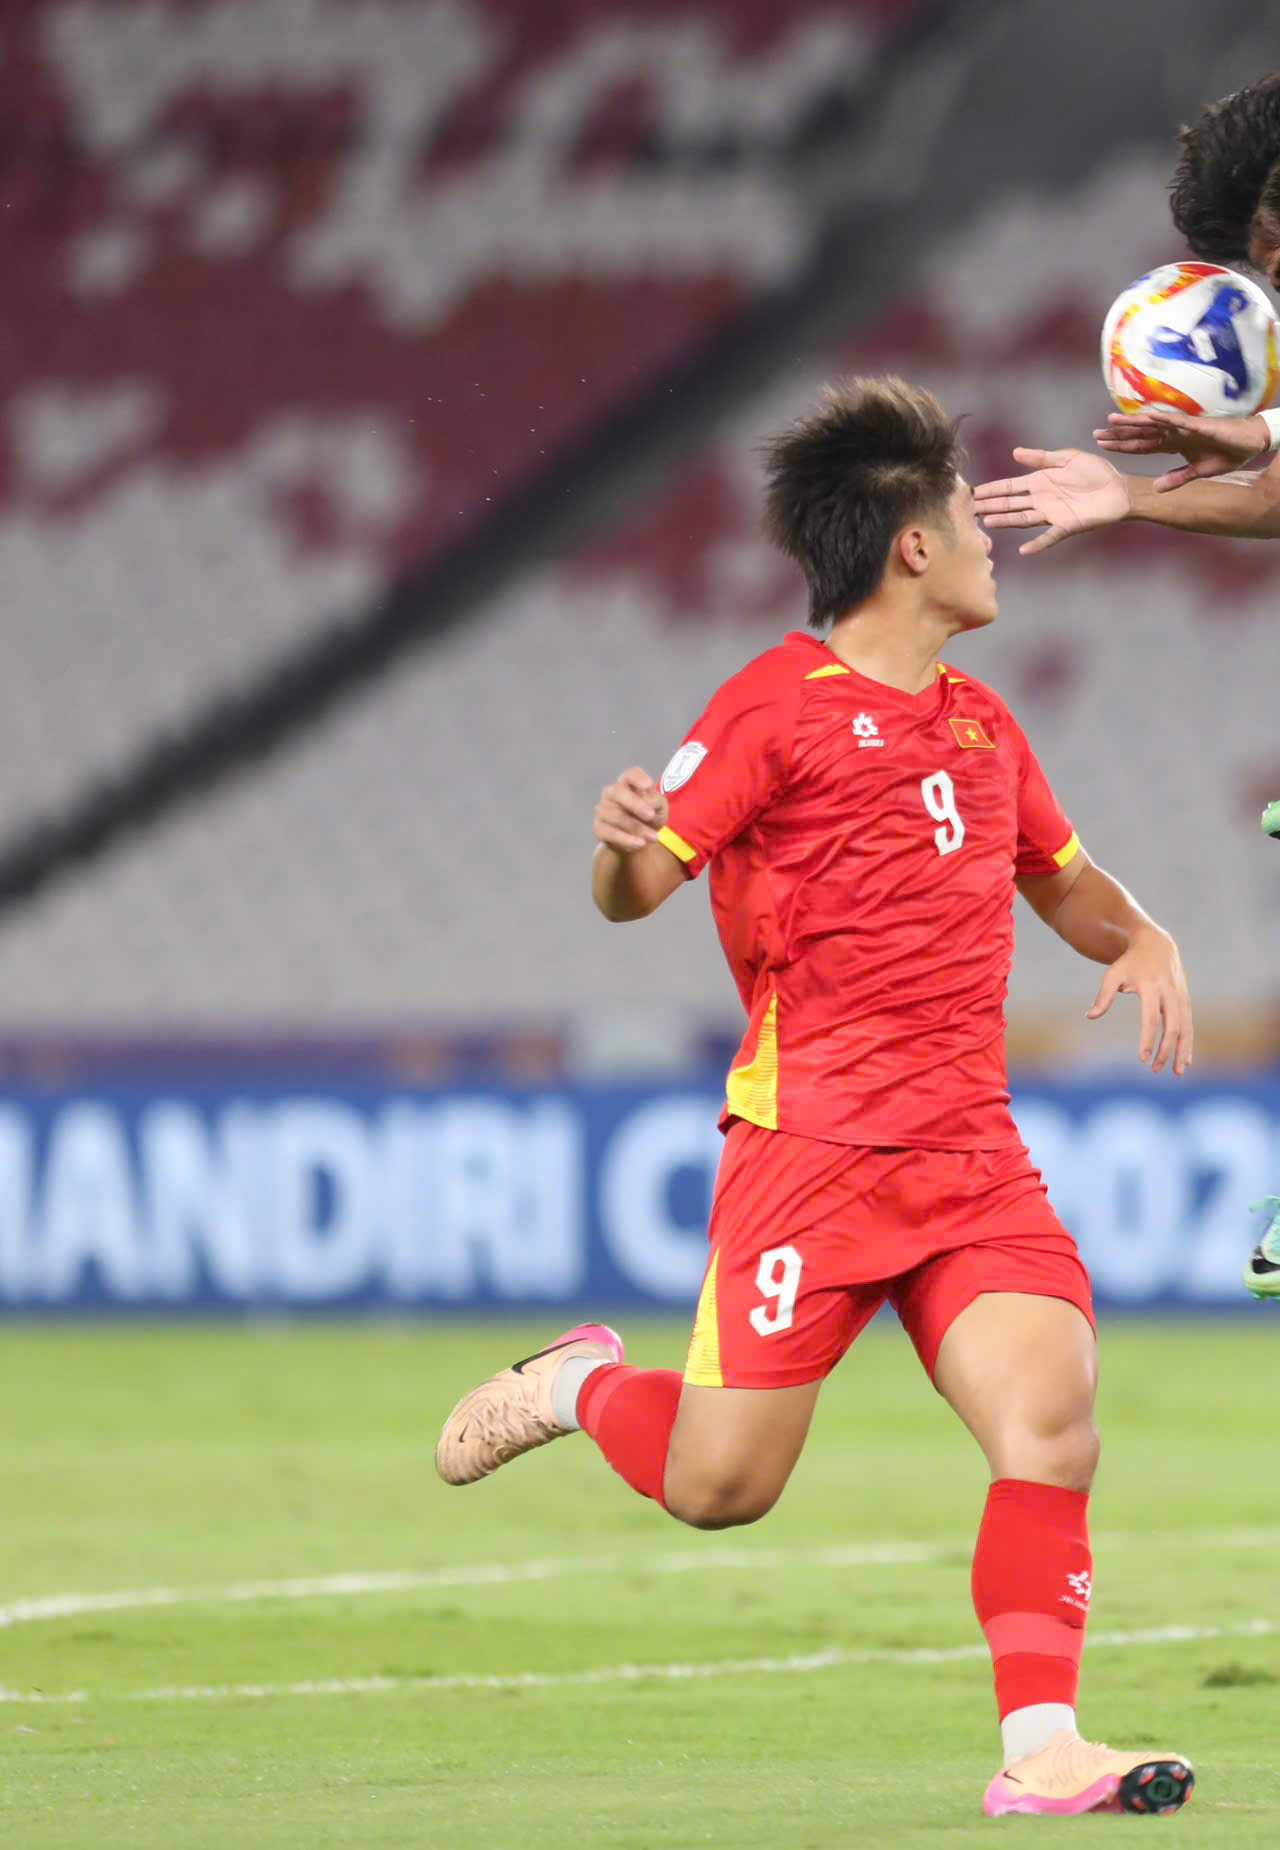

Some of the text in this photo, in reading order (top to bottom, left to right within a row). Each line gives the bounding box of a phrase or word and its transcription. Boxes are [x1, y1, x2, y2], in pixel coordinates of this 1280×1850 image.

[921, 769, 966, 857] 9
[0, 1096, 584, 1302] ANDIRI
[749, 1245, 804, 1337] 9
